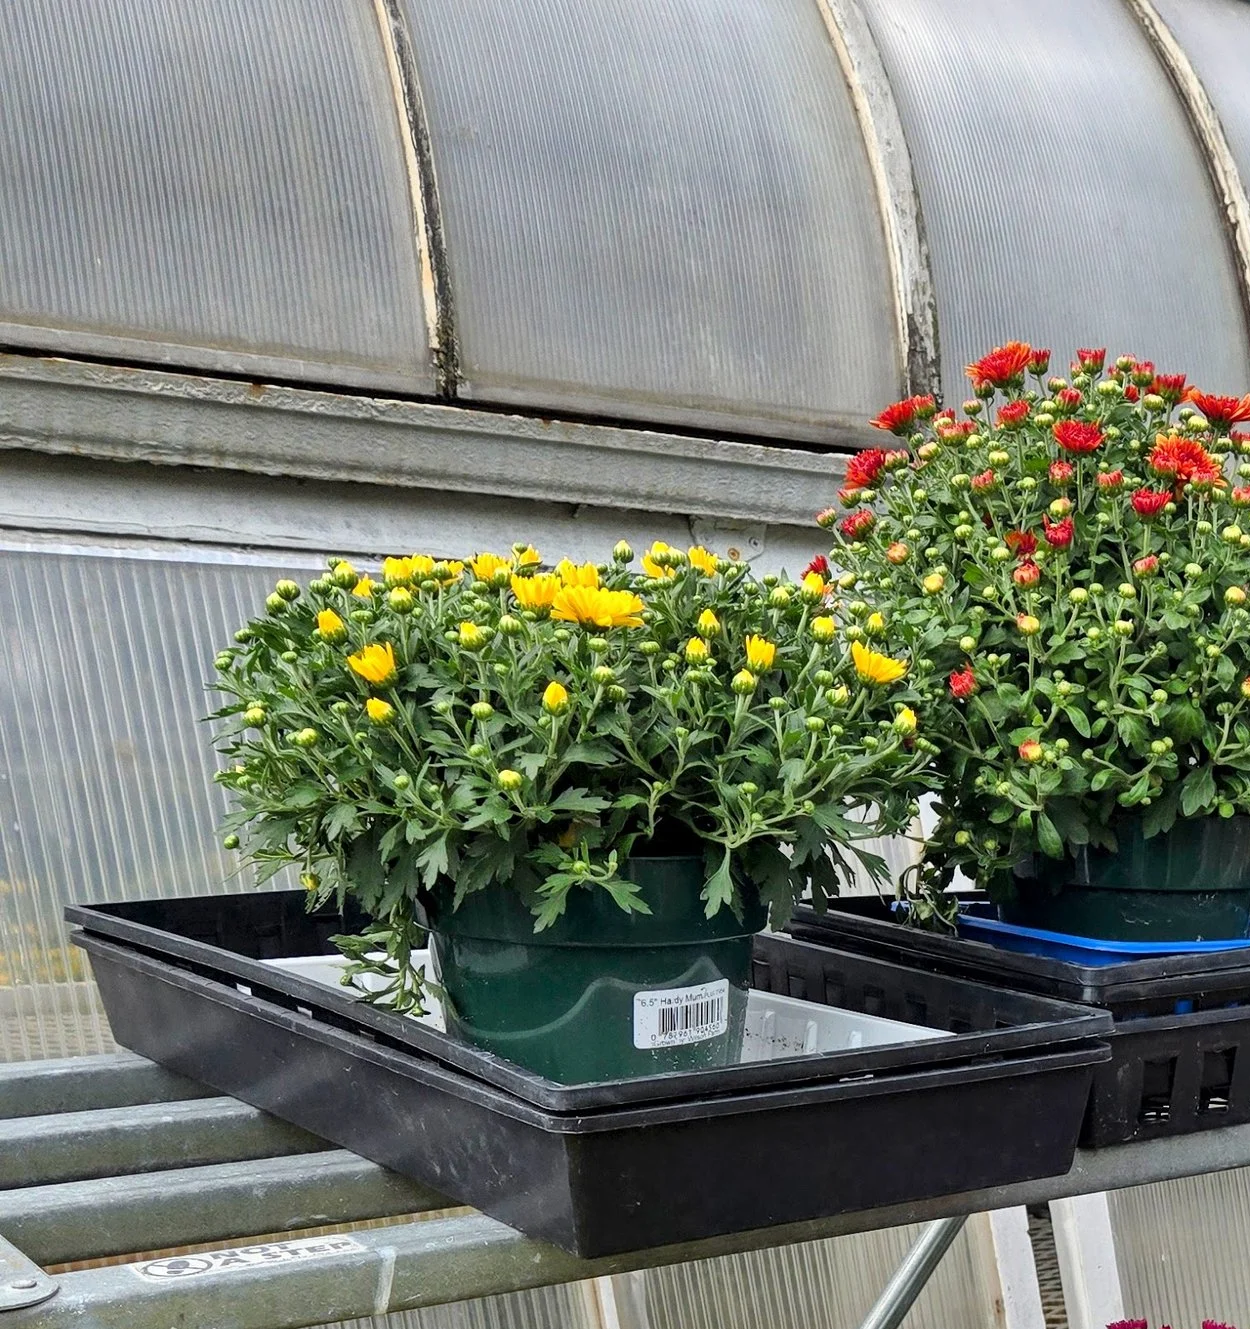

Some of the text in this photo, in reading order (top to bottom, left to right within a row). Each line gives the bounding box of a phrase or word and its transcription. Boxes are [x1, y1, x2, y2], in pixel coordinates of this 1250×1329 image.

[660, 995, 684, 1006] Hady
[685, 992, 704, 1003] Mum
[210, 1242, 293, 1260] NOT
[219, 1257, 250, 1267] A
[261, 1241, 352, 1260] STEP
